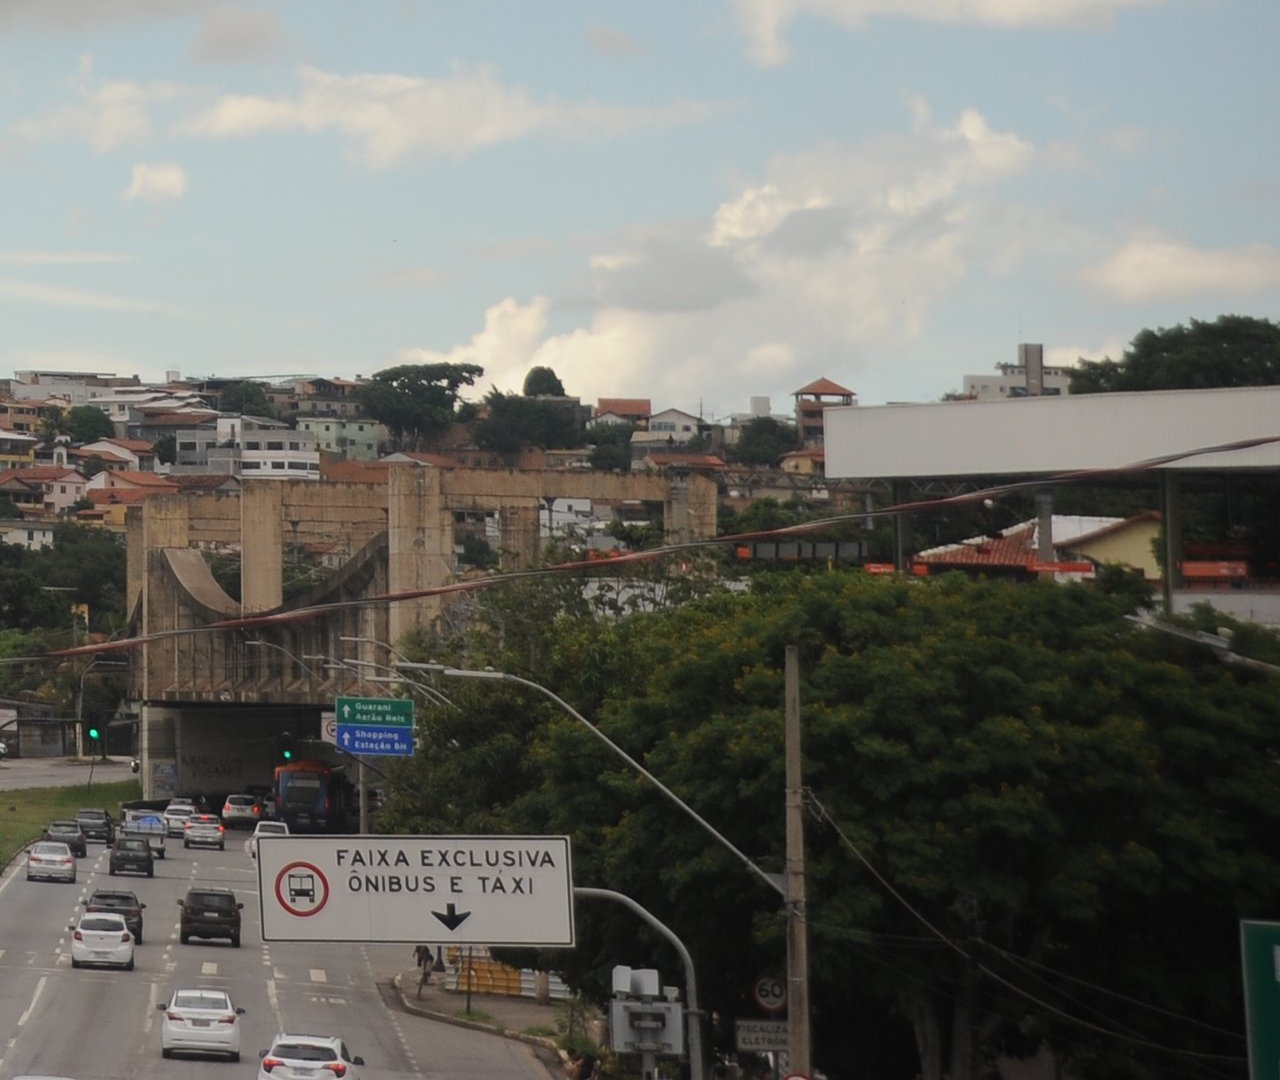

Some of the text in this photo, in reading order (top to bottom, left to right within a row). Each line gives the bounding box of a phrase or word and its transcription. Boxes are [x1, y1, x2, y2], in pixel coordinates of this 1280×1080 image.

[355, 702, 391, 711] Guarani
[355, 730, 399, 740] Shopping
[355, 741, 391, 750] Estação
[336, 849, 555, 867] FAIXA EXCLUSIVA
[348, 870, 533, 895] ÔNIBUS E TÁXI
[758, 983, 783, 999] 60
[736, 1024, 789, 1033] FISCALIZA
[742, 1036, 789, 1045] ELETRÔN
